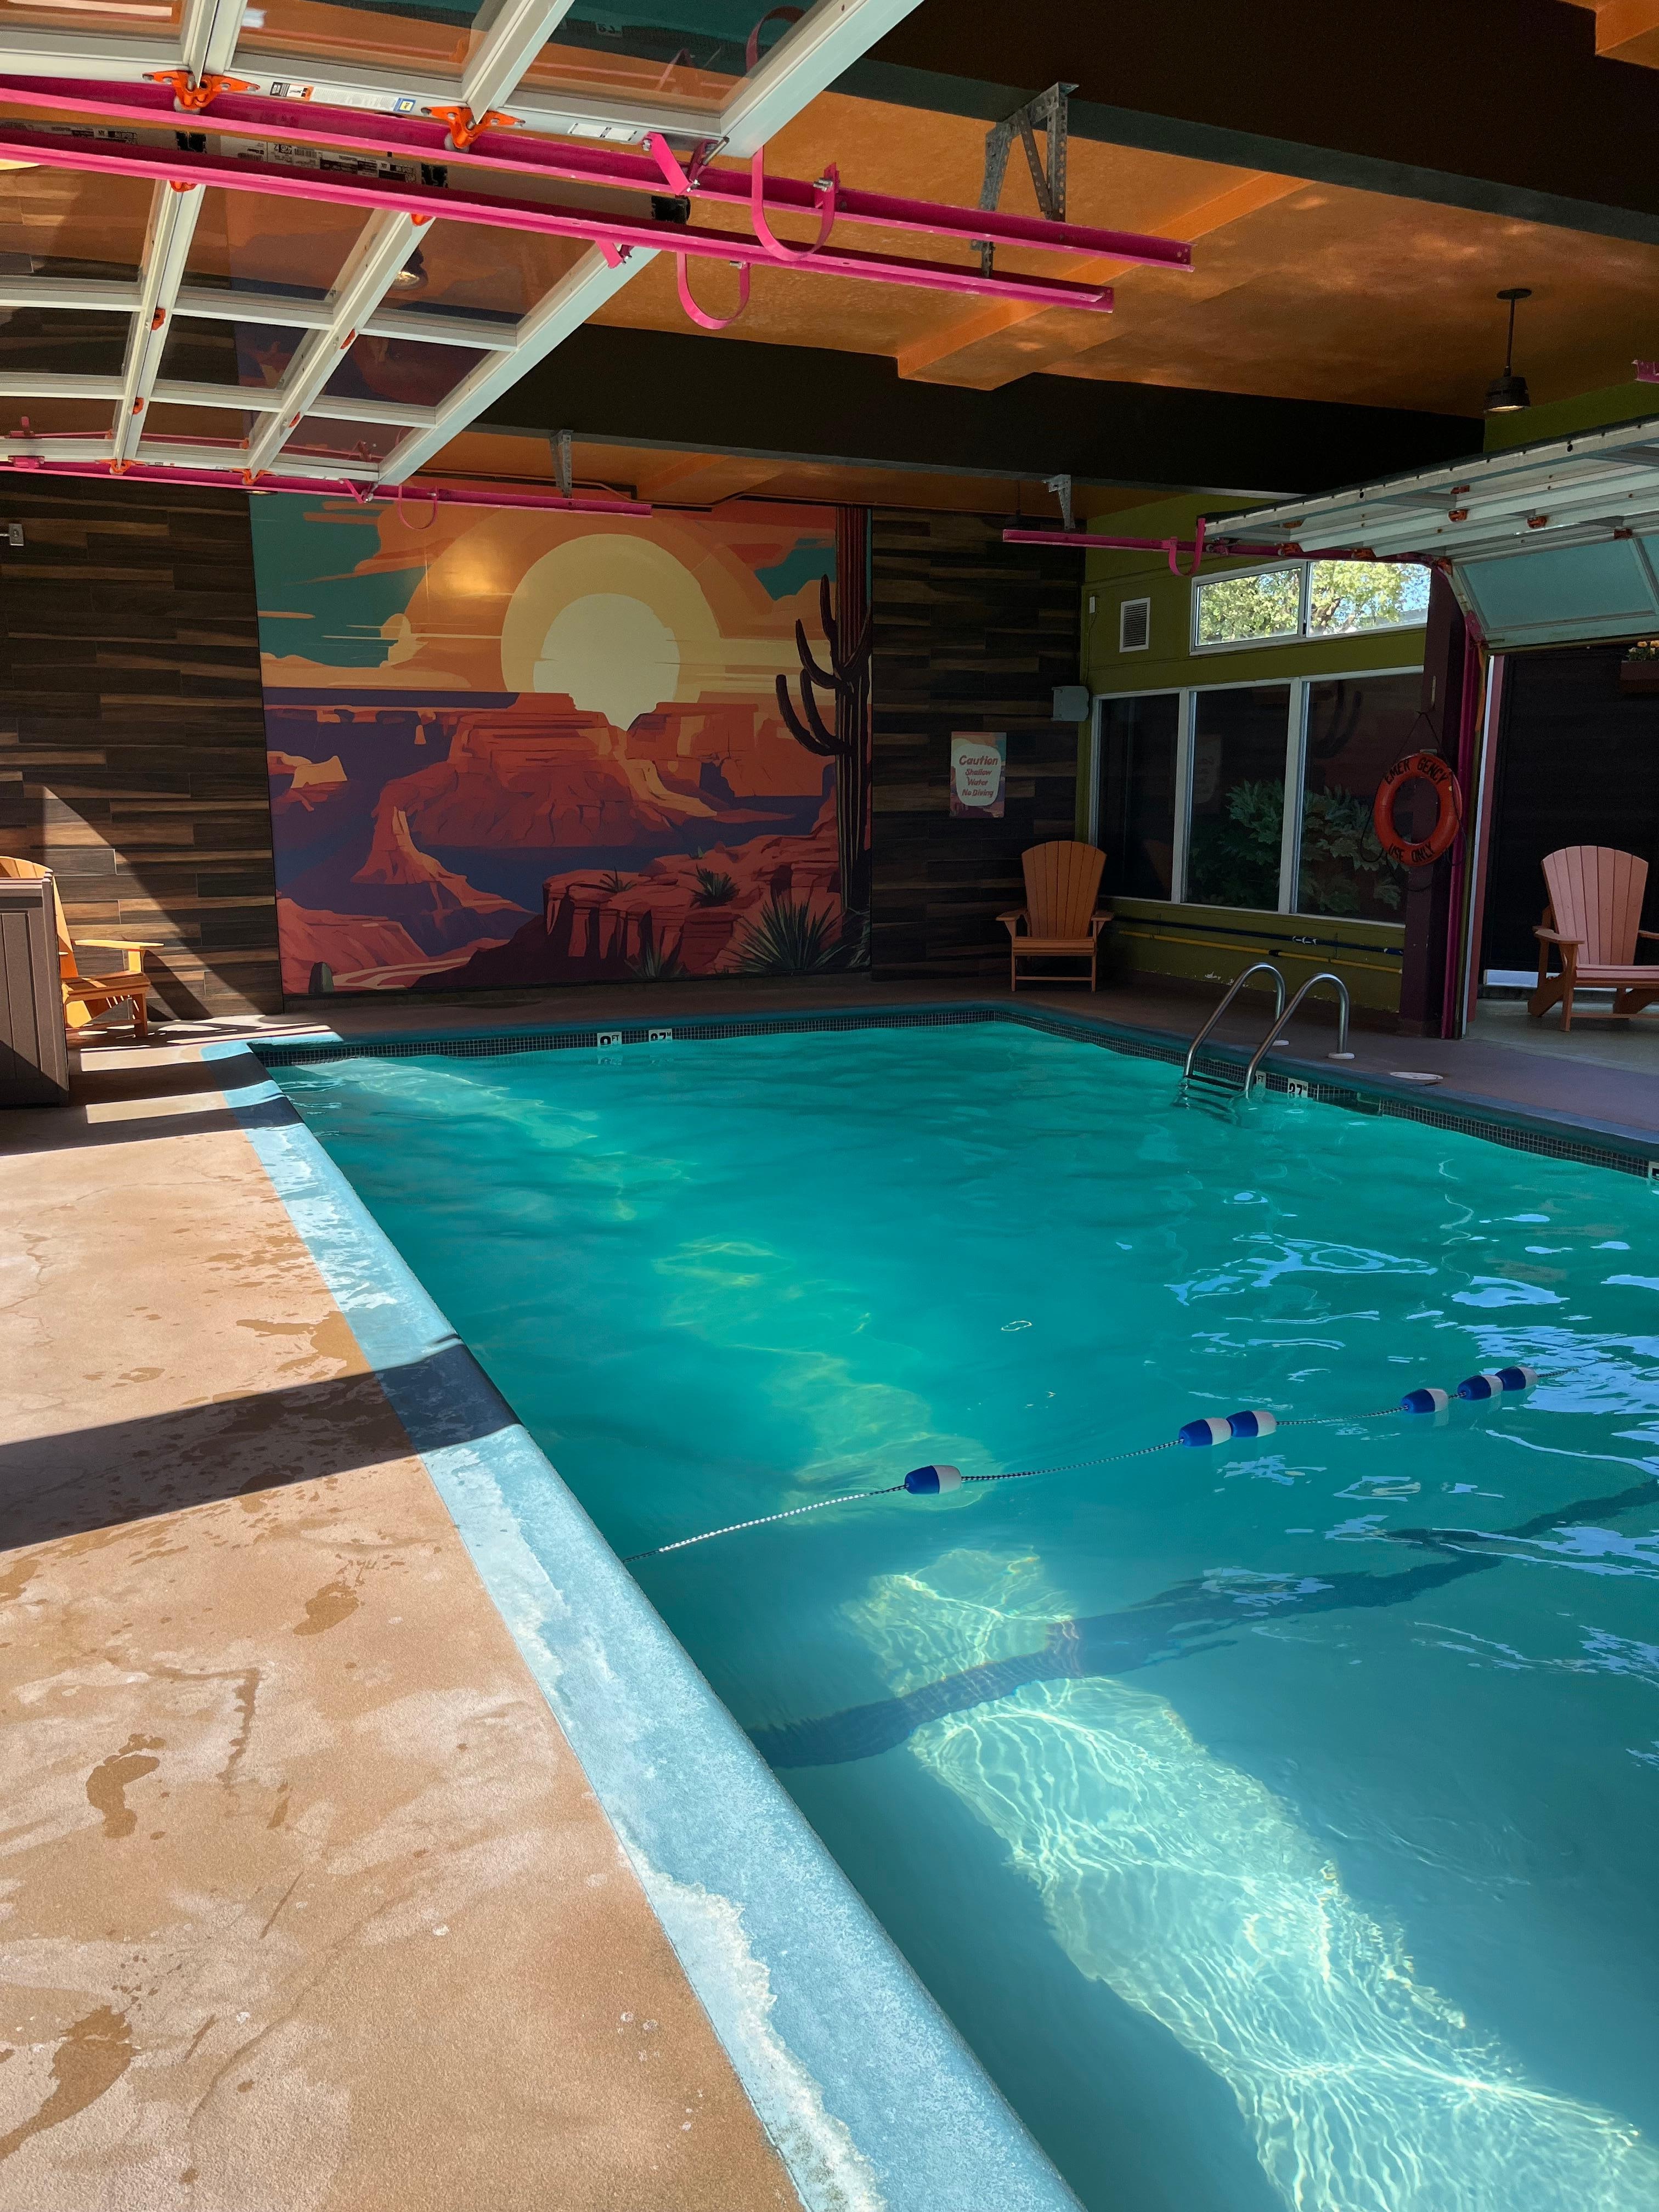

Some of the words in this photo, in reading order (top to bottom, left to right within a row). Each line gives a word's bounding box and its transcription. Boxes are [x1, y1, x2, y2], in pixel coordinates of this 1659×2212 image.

[959, 754, 998, 766] Caution
[966, 777, 988, 786] Water
[973, 789, 994, 798] Diving
[1388, 843, 1406, 863] USE
[1411, 842, 1435, 863] ONLY
